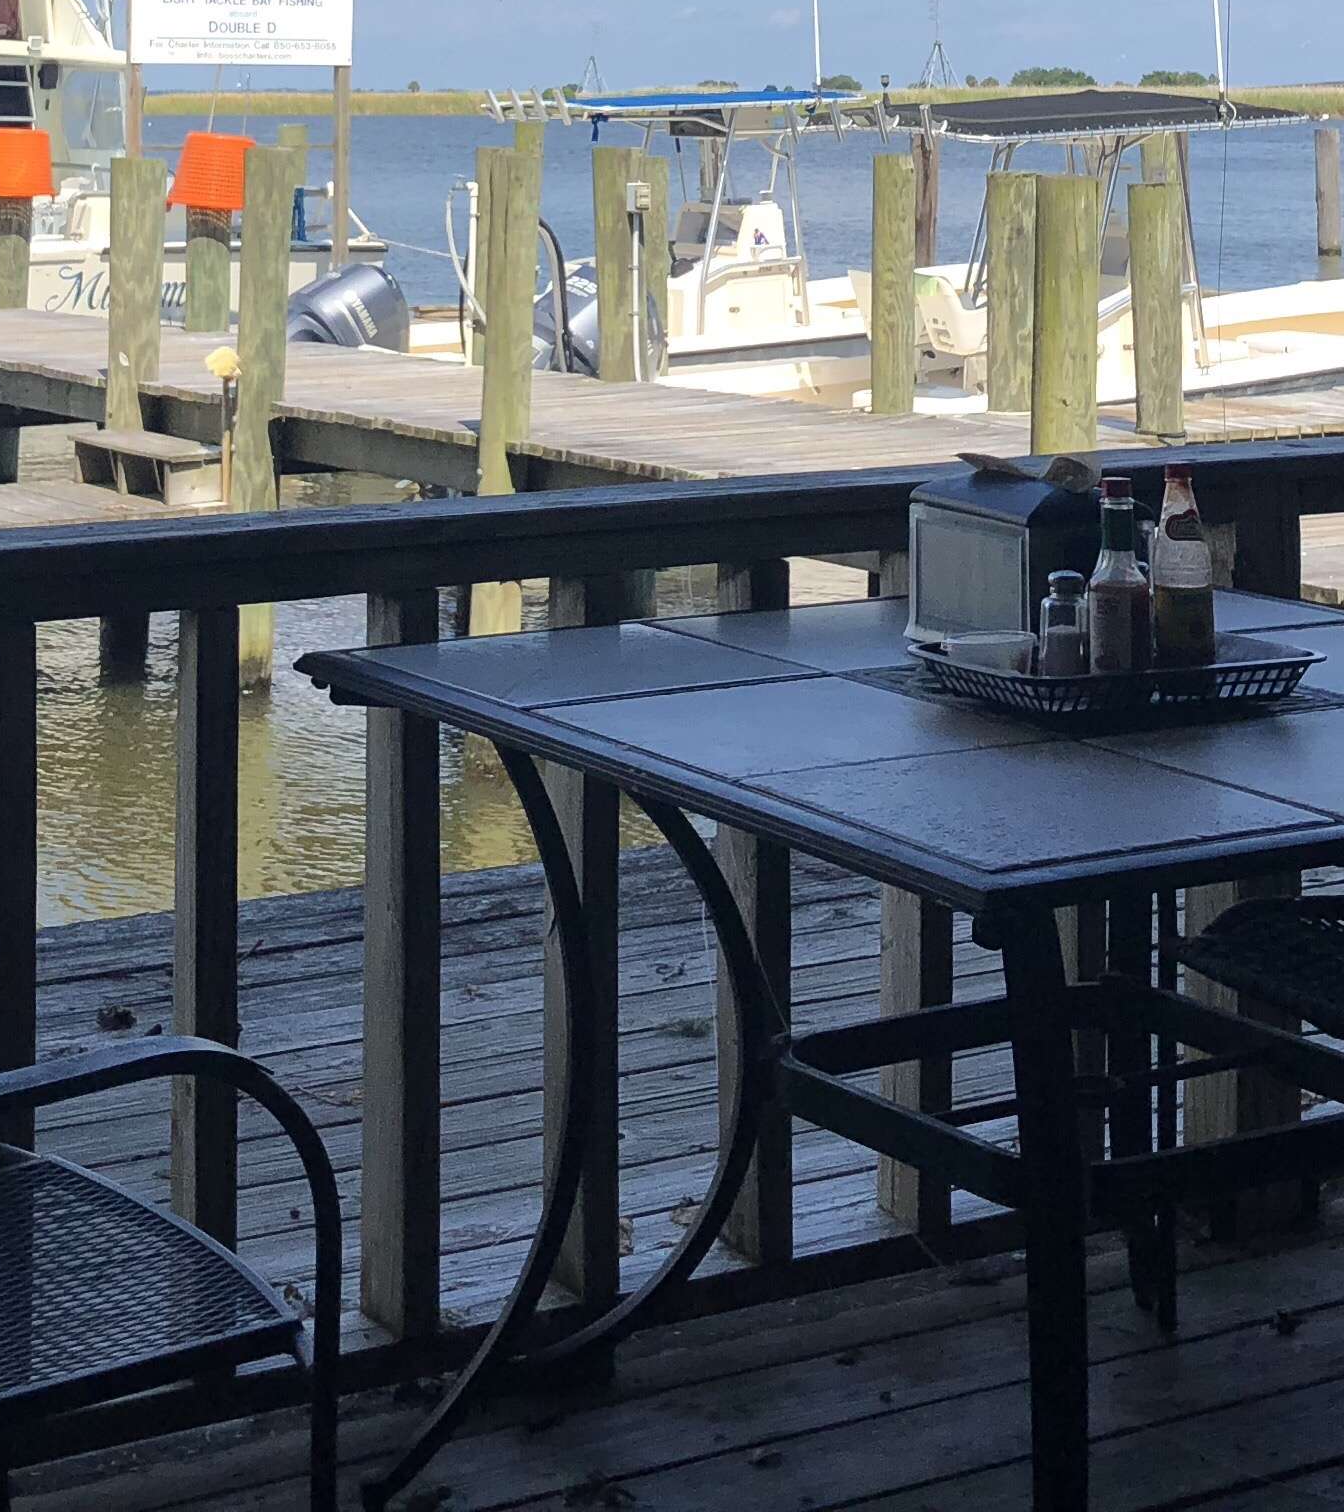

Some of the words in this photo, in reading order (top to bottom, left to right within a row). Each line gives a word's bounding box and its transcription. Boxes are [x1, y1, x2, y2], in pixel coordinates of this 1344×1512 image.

[208, 21, 262, 34] DOUBLE
[267, 22, 277, 34] D
[168, 39, 200, 49] Charter
[203, 40, 250, 49] Information
[254, 40, 270, 49] Call
[566, 275, 598, 294] 225
[351, 297, 378, 338] YAMAHA
